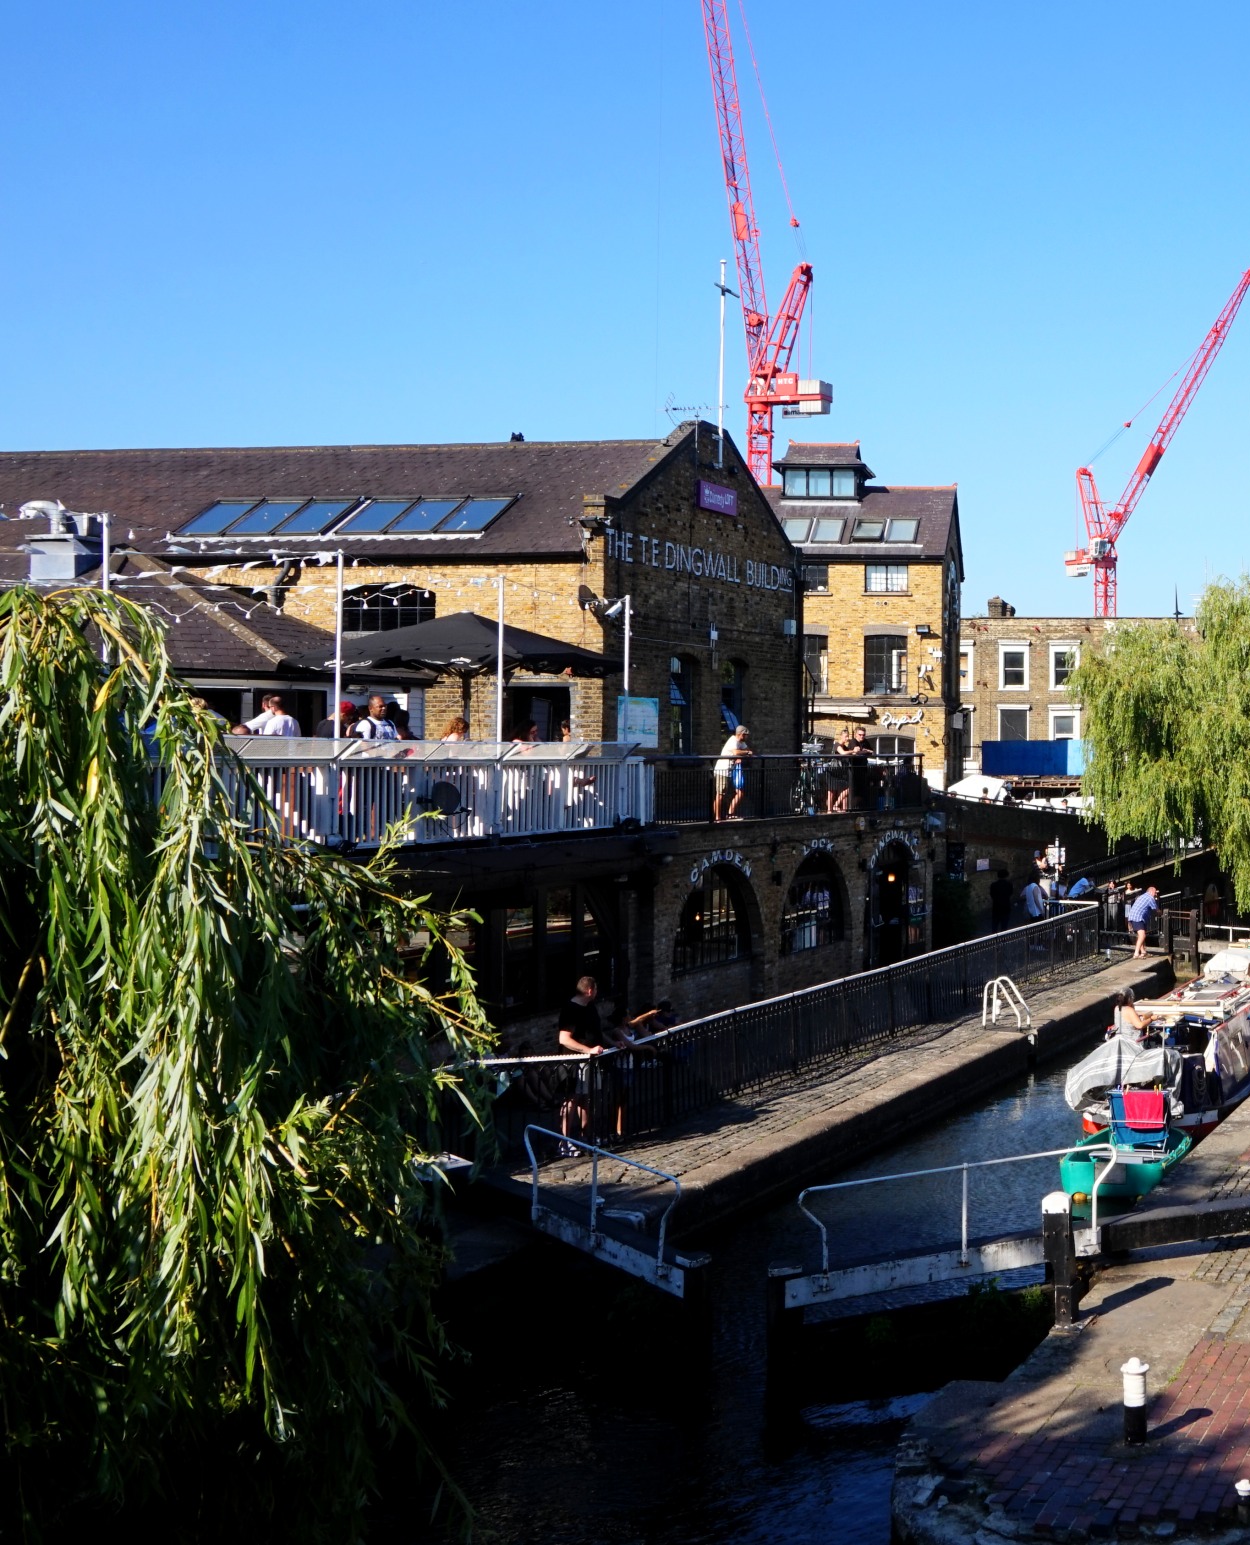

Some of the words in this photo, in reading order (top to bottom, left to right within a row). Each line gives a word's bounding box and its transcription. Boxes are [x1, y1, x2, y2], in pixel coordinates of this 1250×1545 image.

[605, 528, 634, 563] THE
[665, 541, 741, 583] DINGWALL
[747, 559, 793, 592] BUILDING
[803, 838, 835, 856] LOCK
[690, 849, 752, 883] CAMDEN
